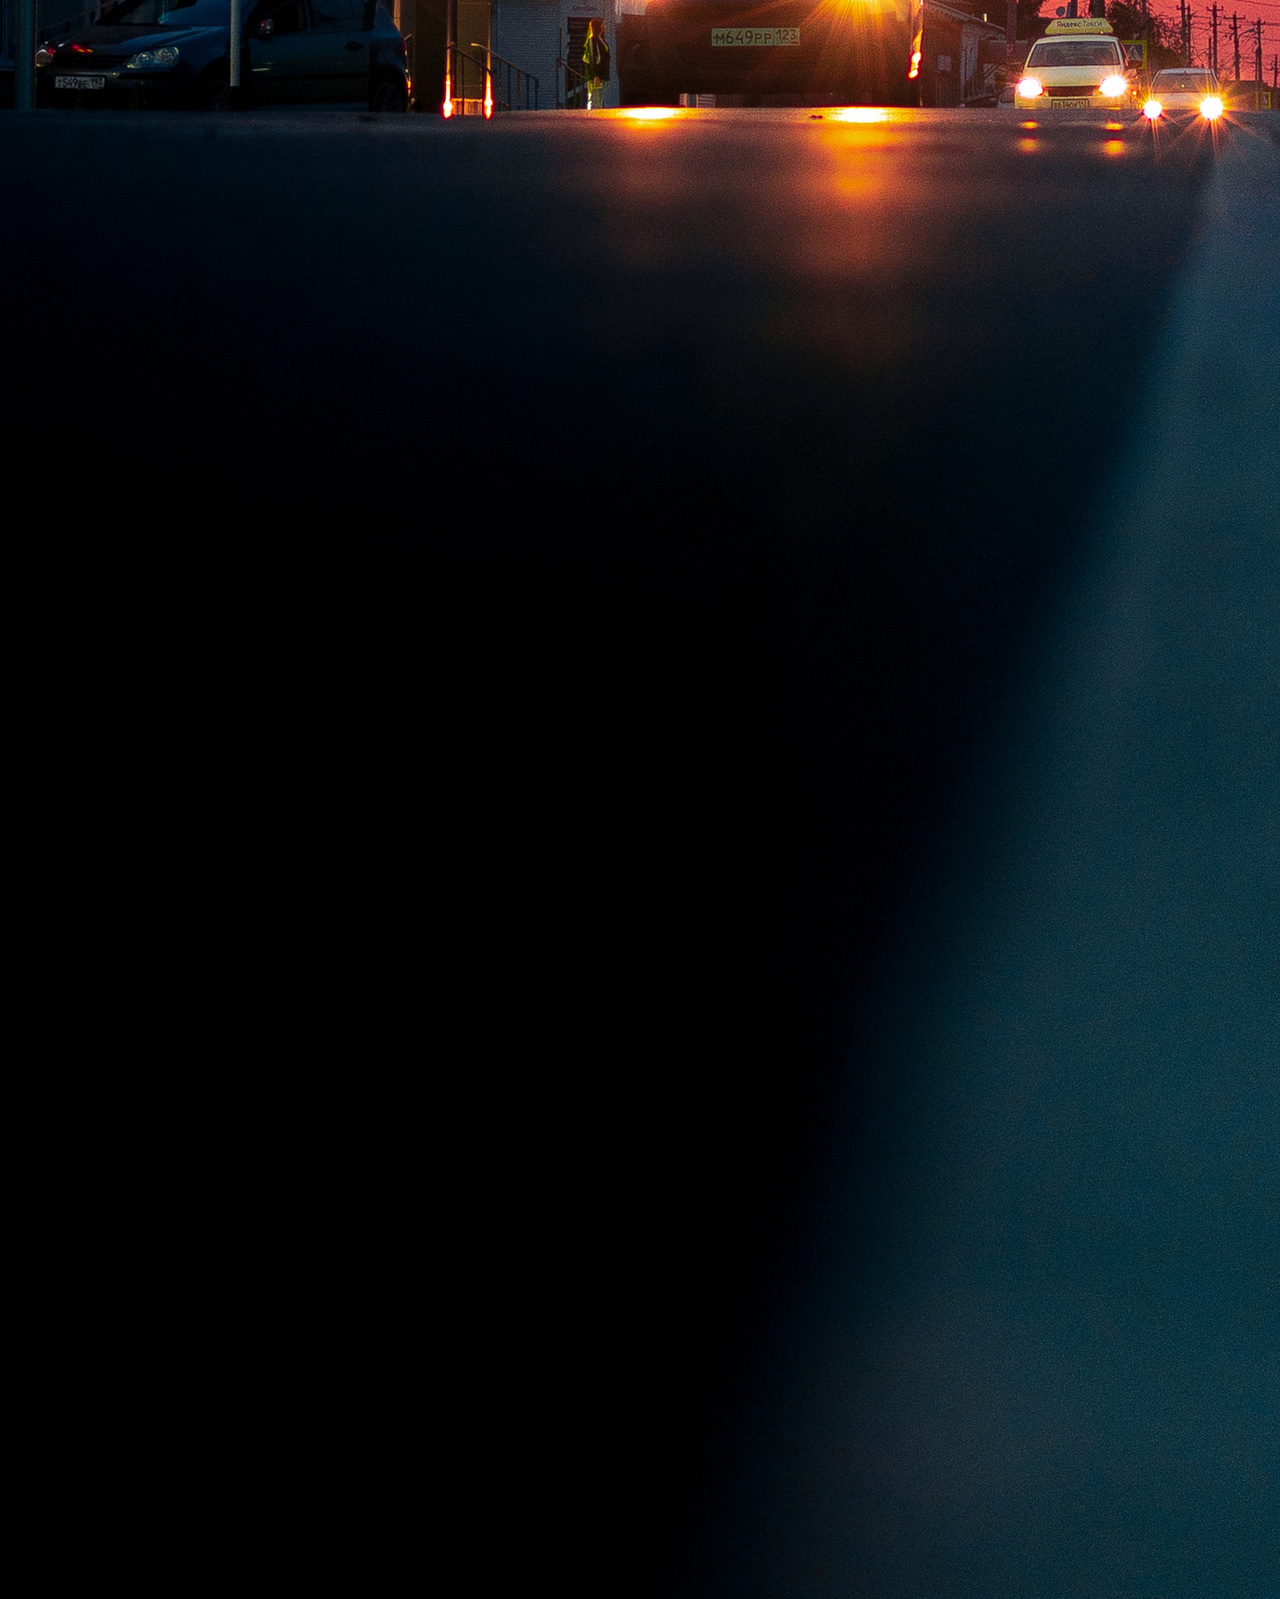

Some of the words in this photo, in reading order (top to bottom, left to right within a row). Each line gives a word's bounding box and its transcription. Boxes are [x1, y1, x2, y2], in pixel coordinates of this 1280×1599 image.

[1056, 20, 1082, 29] Яндекс
[1083, 20, 1103, 28] Такси
[714, 30, 773, 45] М649РР
[775, 29, 797, 41] 123
